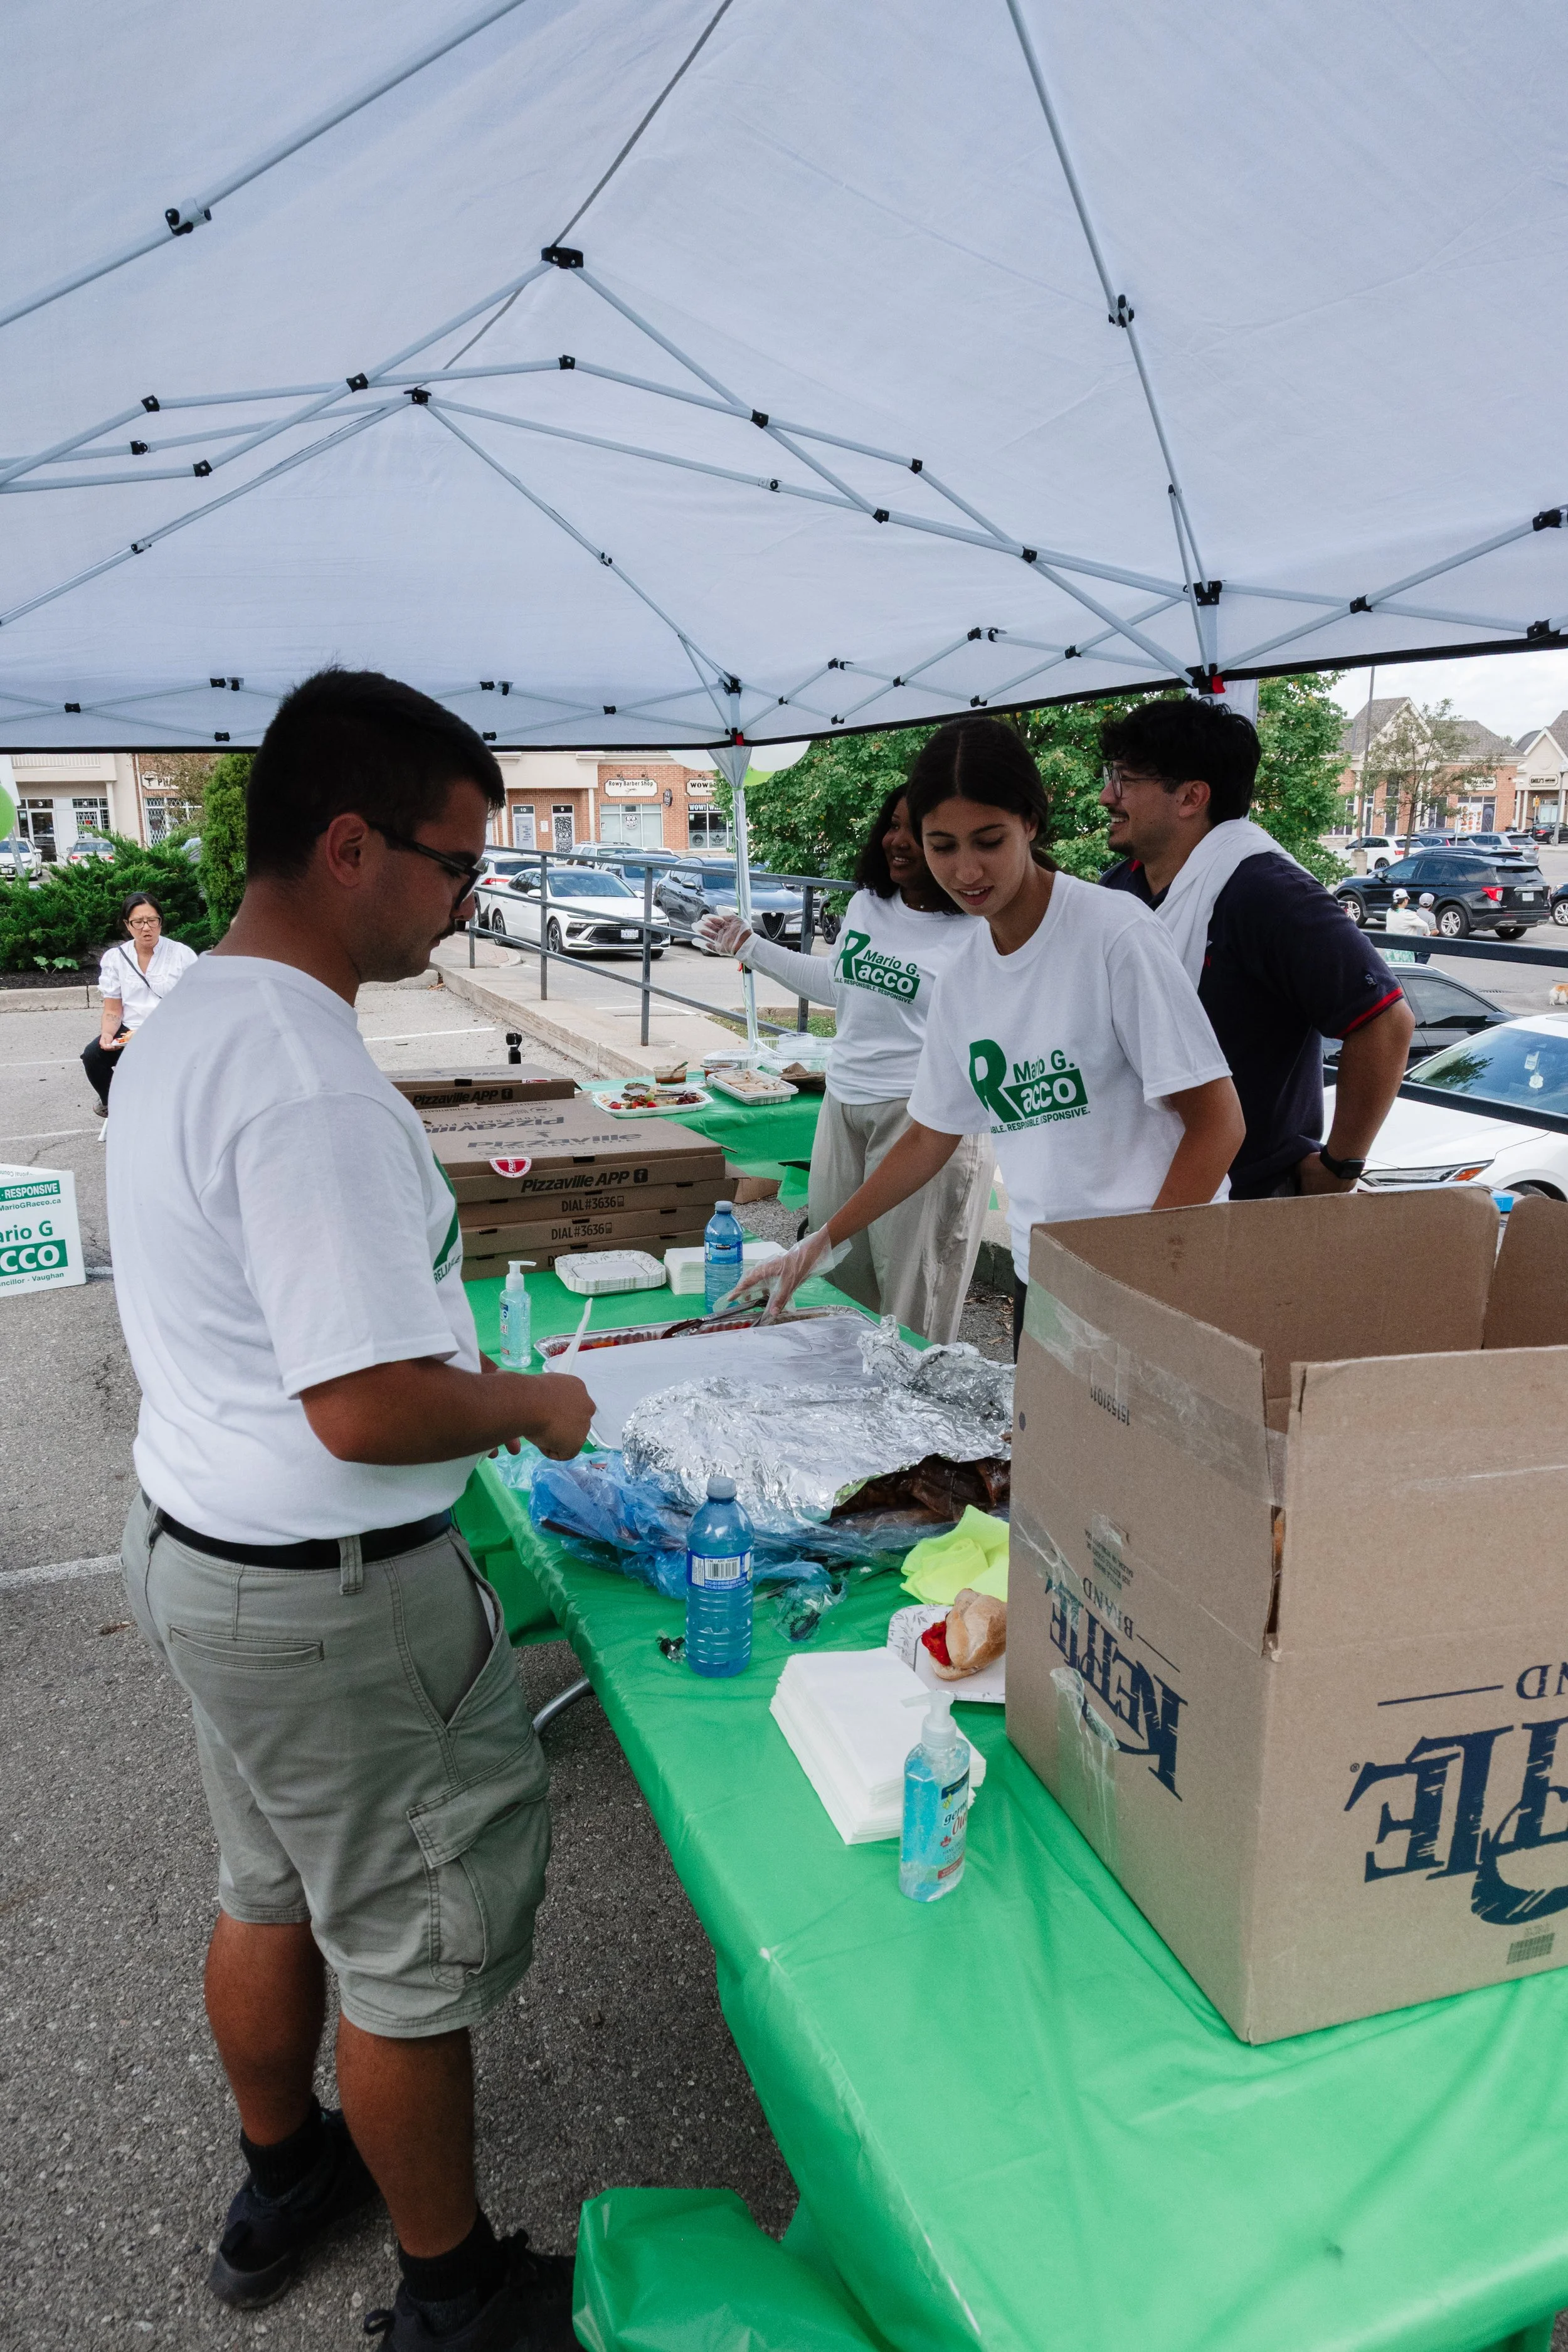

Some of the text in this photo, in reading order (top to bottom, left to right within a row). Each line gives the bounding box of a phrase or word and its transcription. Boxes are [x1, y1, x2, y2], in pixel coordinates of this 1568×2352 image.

[863, 949, 920, 978] Mario G.
[844, 978, 877, 993] RESPONSIBLE.
[877, 988, 913, 1005] RESPONSIVE.
[1051, 1049, 1075, 1071] G.
[413, 1089, 499, 1106] Pizzaville APP
[425, 1116, 564, 1134] Pizzavill
[467, 1133, 642, 1148] Pizzaville
[4, 1183, 58, 1199] RESPONSIVE
[521, 1171, 630, 1193] Pizzaville APP
[39, 1220, 53, 1237] G
[32, 1272, 64, 1281] Vaughan
[1082, 1577, 1134, 1642] BRAND
[1044, 1571, 1189, 1803] KETTLE
